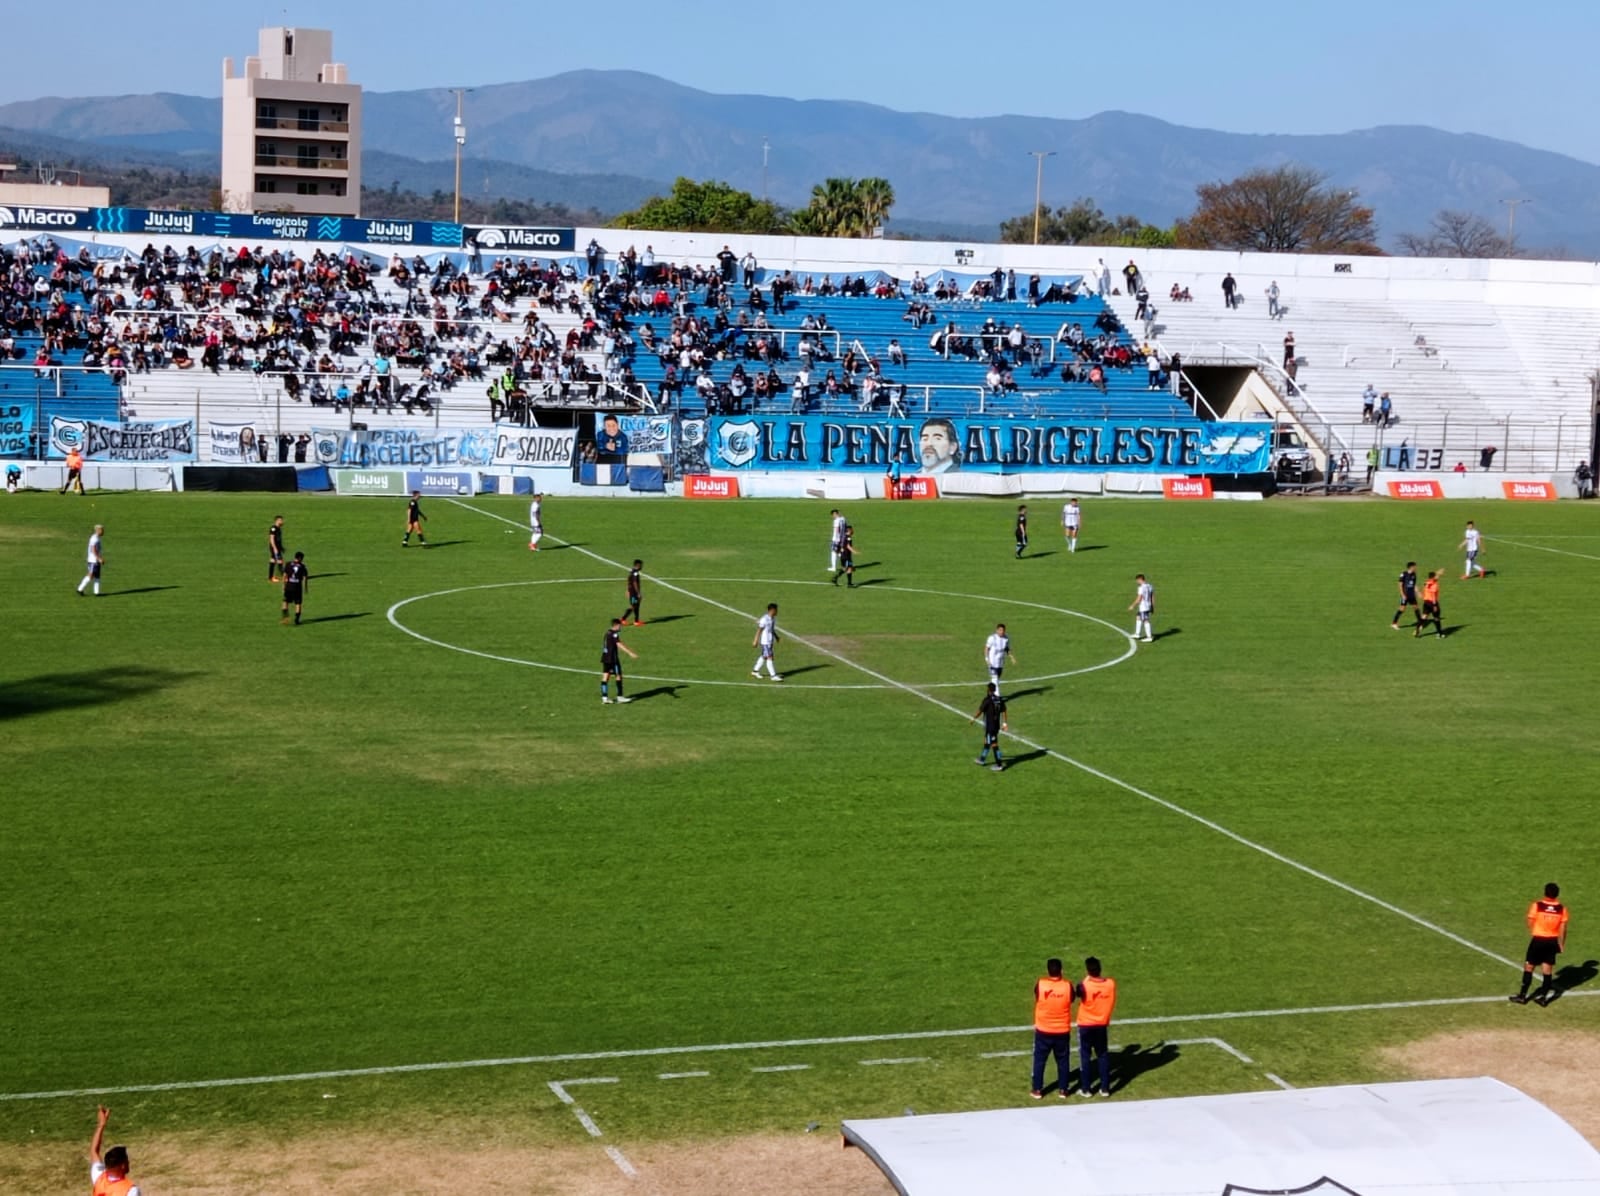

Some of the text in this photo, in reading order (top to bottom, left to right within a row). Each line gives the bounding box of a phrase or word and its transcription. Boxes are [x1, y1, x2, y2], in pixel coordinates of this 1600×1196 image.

[18, 208, 77, 225] Macro
[508, 230, 560, 246] Macro
[762, 420, 919, 467] LA PEÑA
[963, 424, 1202, 467] ALBICELESTE
[1385, 446, 1444, 470] LA 33
